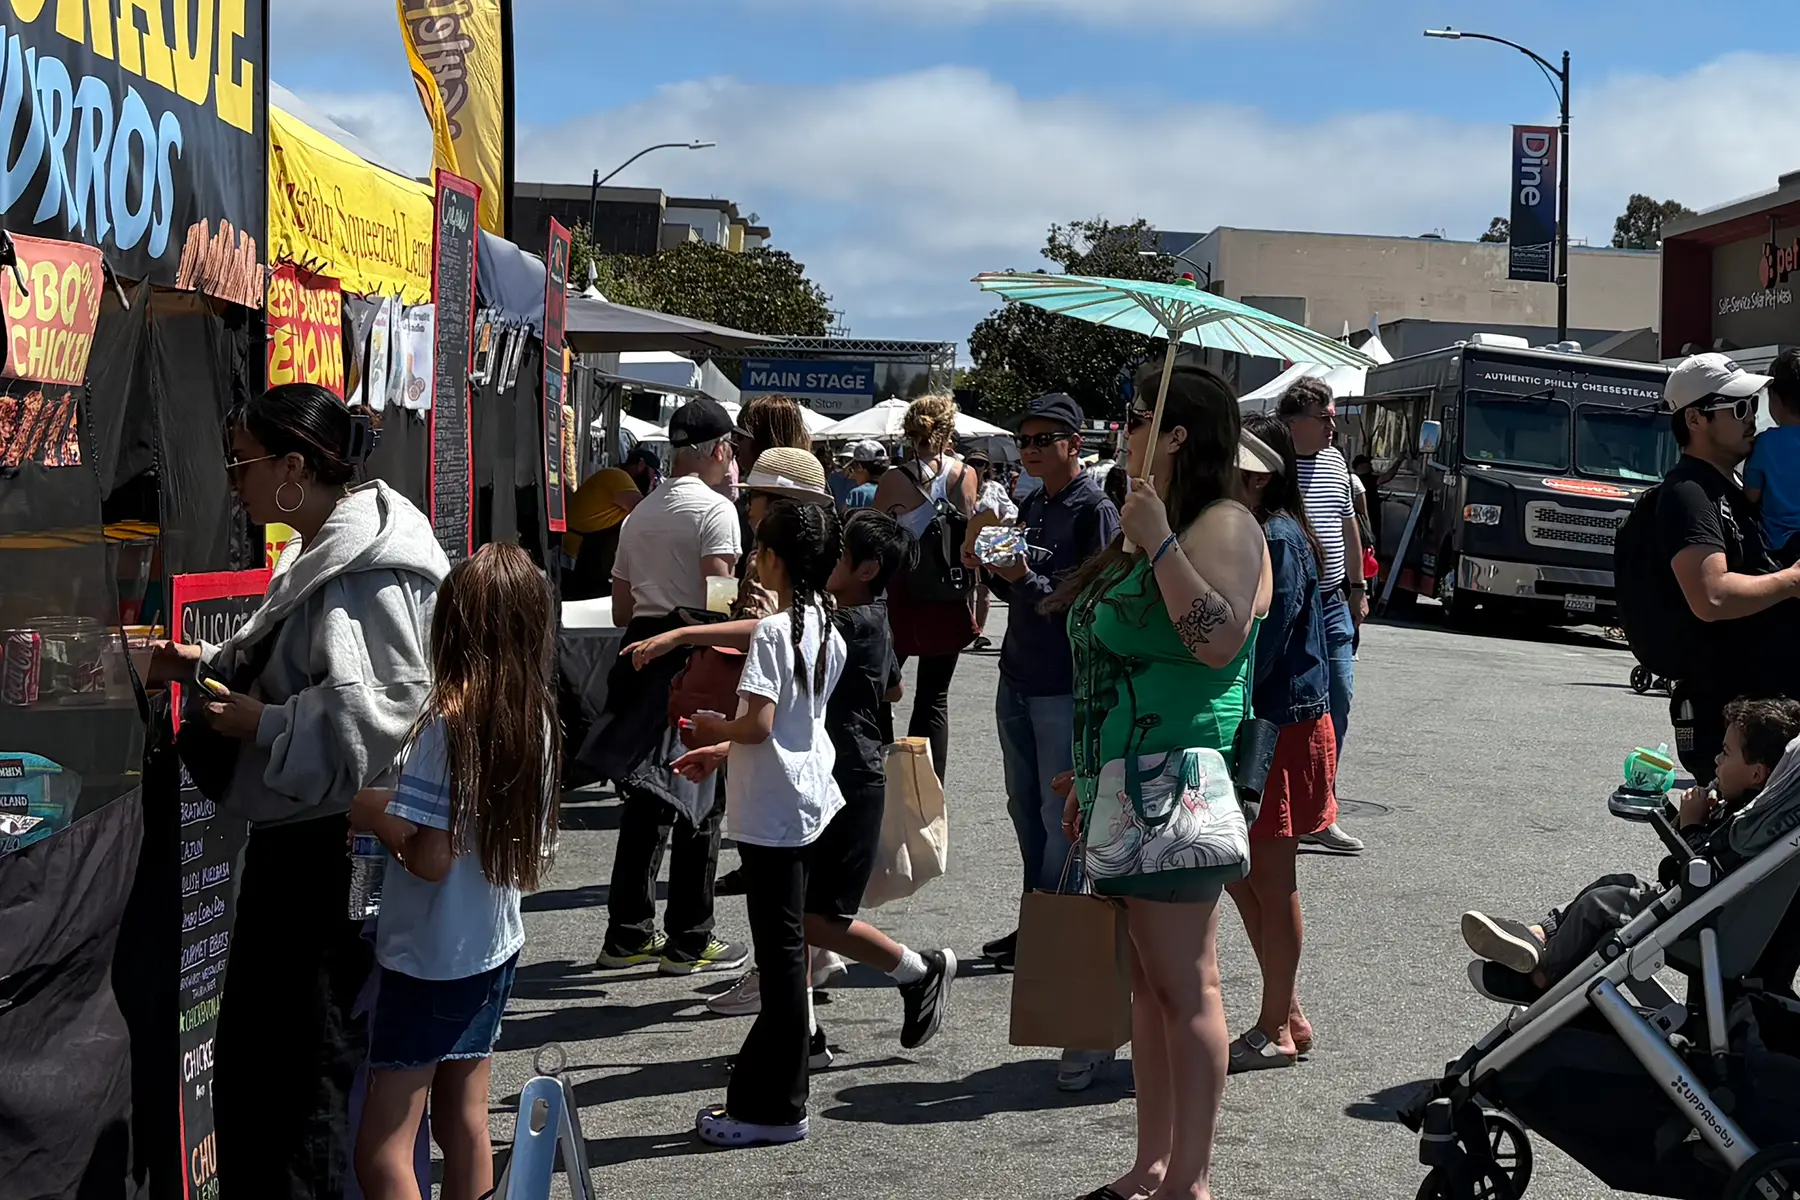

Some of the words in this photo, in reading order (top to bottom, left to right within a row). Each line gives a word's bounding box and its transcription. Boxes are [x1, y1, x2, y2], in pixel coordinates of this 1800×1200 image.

[0, 25, 183, 259] URROS
[1520, 132, 1550, 206] Dine
[334, 185, 402, 278] Squeezed
[8, 257, 82, 327] BBQ
[11, 324, 93, 383] CHICKEN
[750, 371, 800, 387] MAIN
[806, 373, 865, 390] STAGE
[1485, 372, 1541, 385] AUTHENTIC
[1545, 378, 1578, 389] PHILLY
[1582, 382, 1659, 399] CHEESESTEAKS
[1684, 1088, 1735, 1148] UPPAbaby
[192, 1131, 217, 1187] CHU
